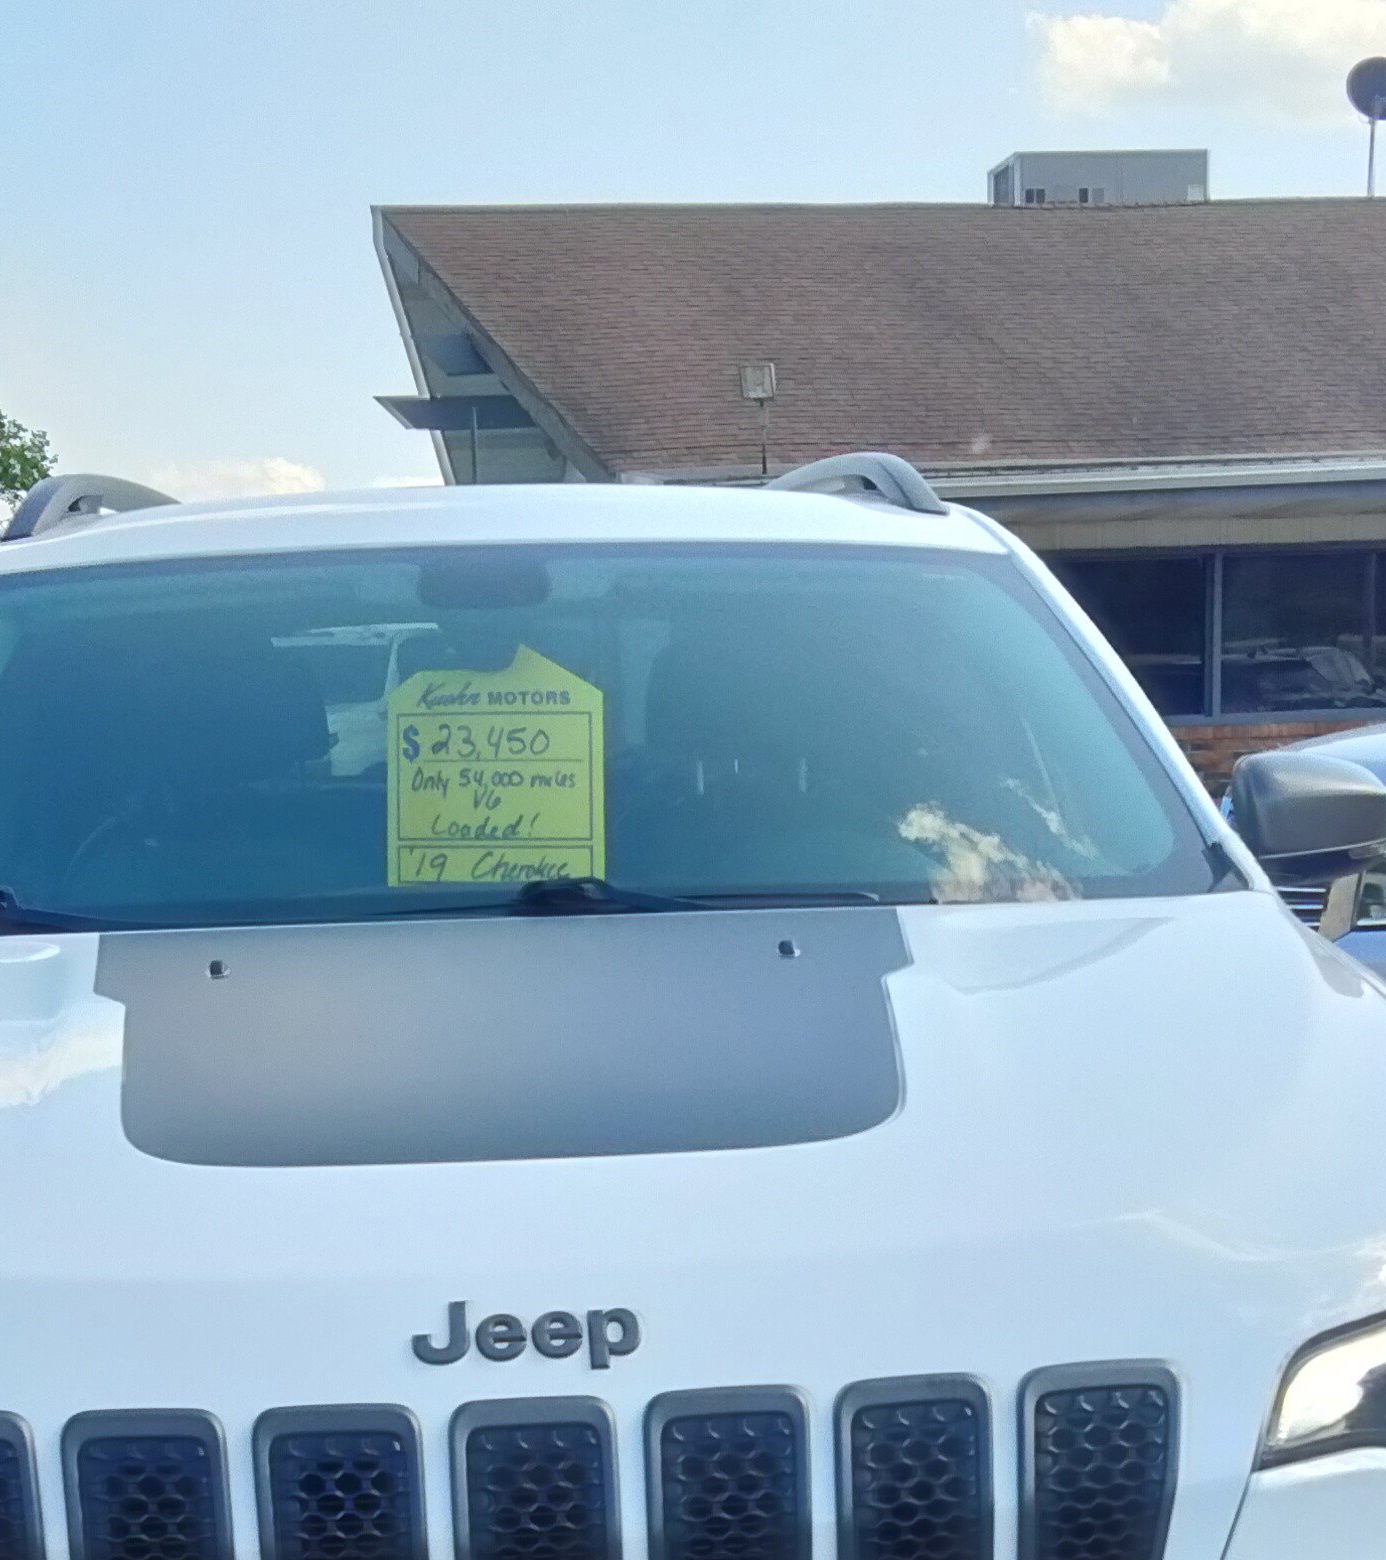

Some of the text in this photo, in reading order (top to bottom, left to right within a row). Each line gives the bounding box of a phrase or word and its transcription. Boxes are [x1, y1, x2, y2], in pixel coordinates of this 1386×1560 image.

[487, 690, 571, 706] MOTORS
[402, 724, 550, 763] $ 23,450
[411, 766, 576, 799] Only 54,000 miles
[473, 788, 502, 810] V6
[431, 812, 541, 840] Loaded!
[470, 851, 571, 881] Cherokee
[411, 1300, 642, 1370] Jeep
